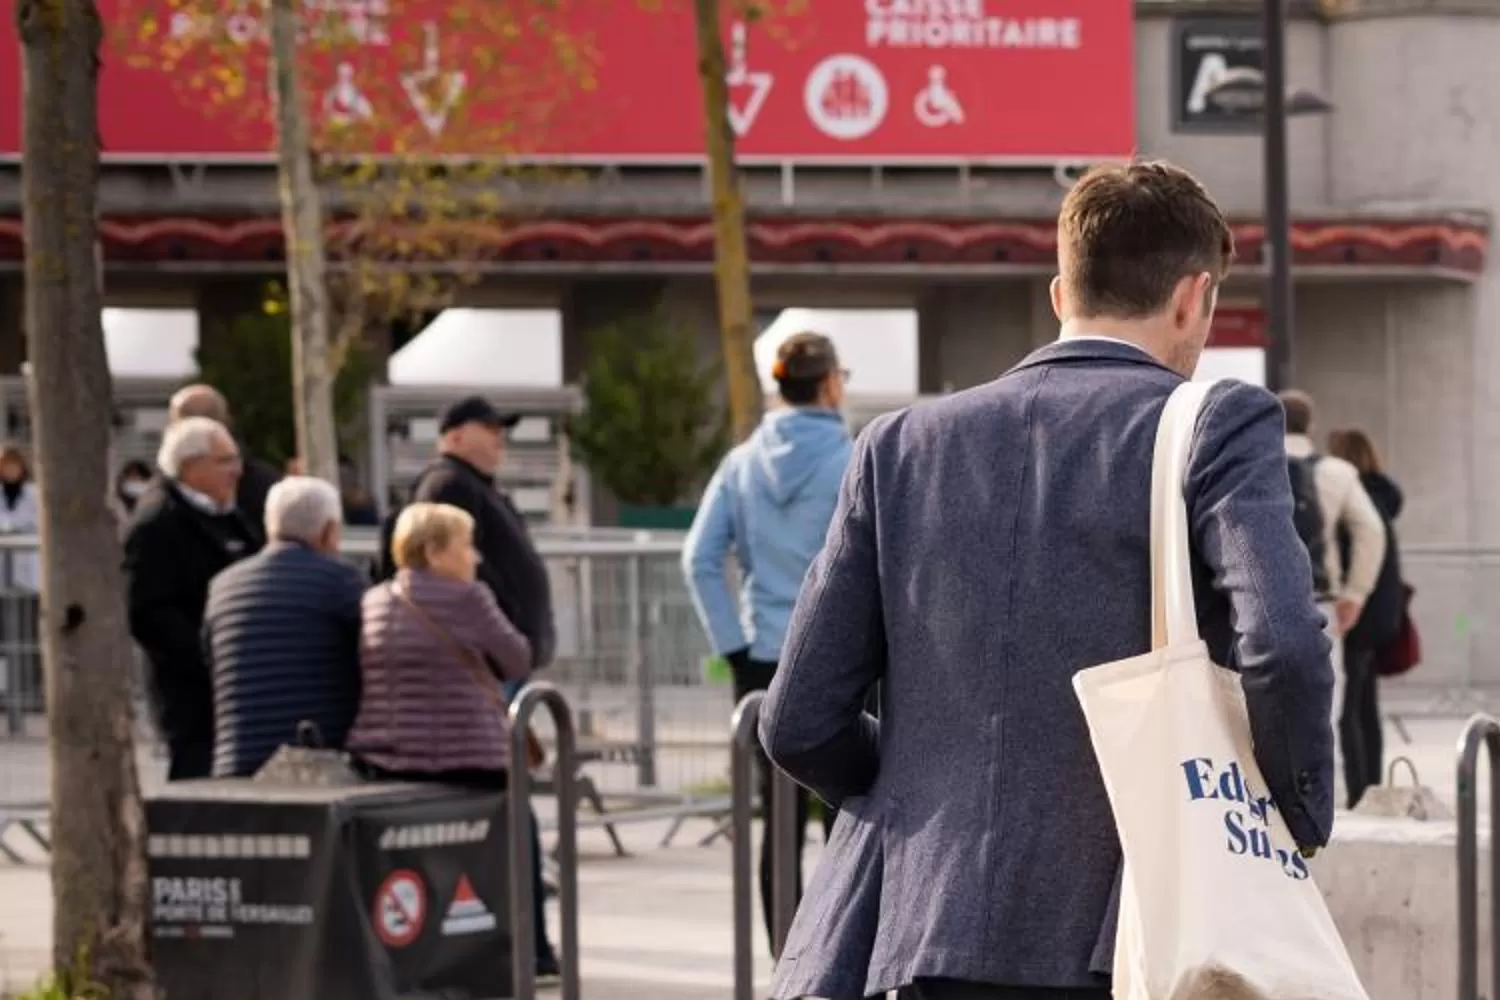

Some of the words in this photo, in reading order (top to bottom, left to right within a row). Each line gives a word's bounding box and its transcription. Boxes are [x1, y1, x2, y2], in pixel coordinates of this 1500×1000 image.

[865, 0, 984, 18] CAISSE
[866, 18, 1081, 48] PRIORITAIRE
[153, 876, 228, 902] PARIS
